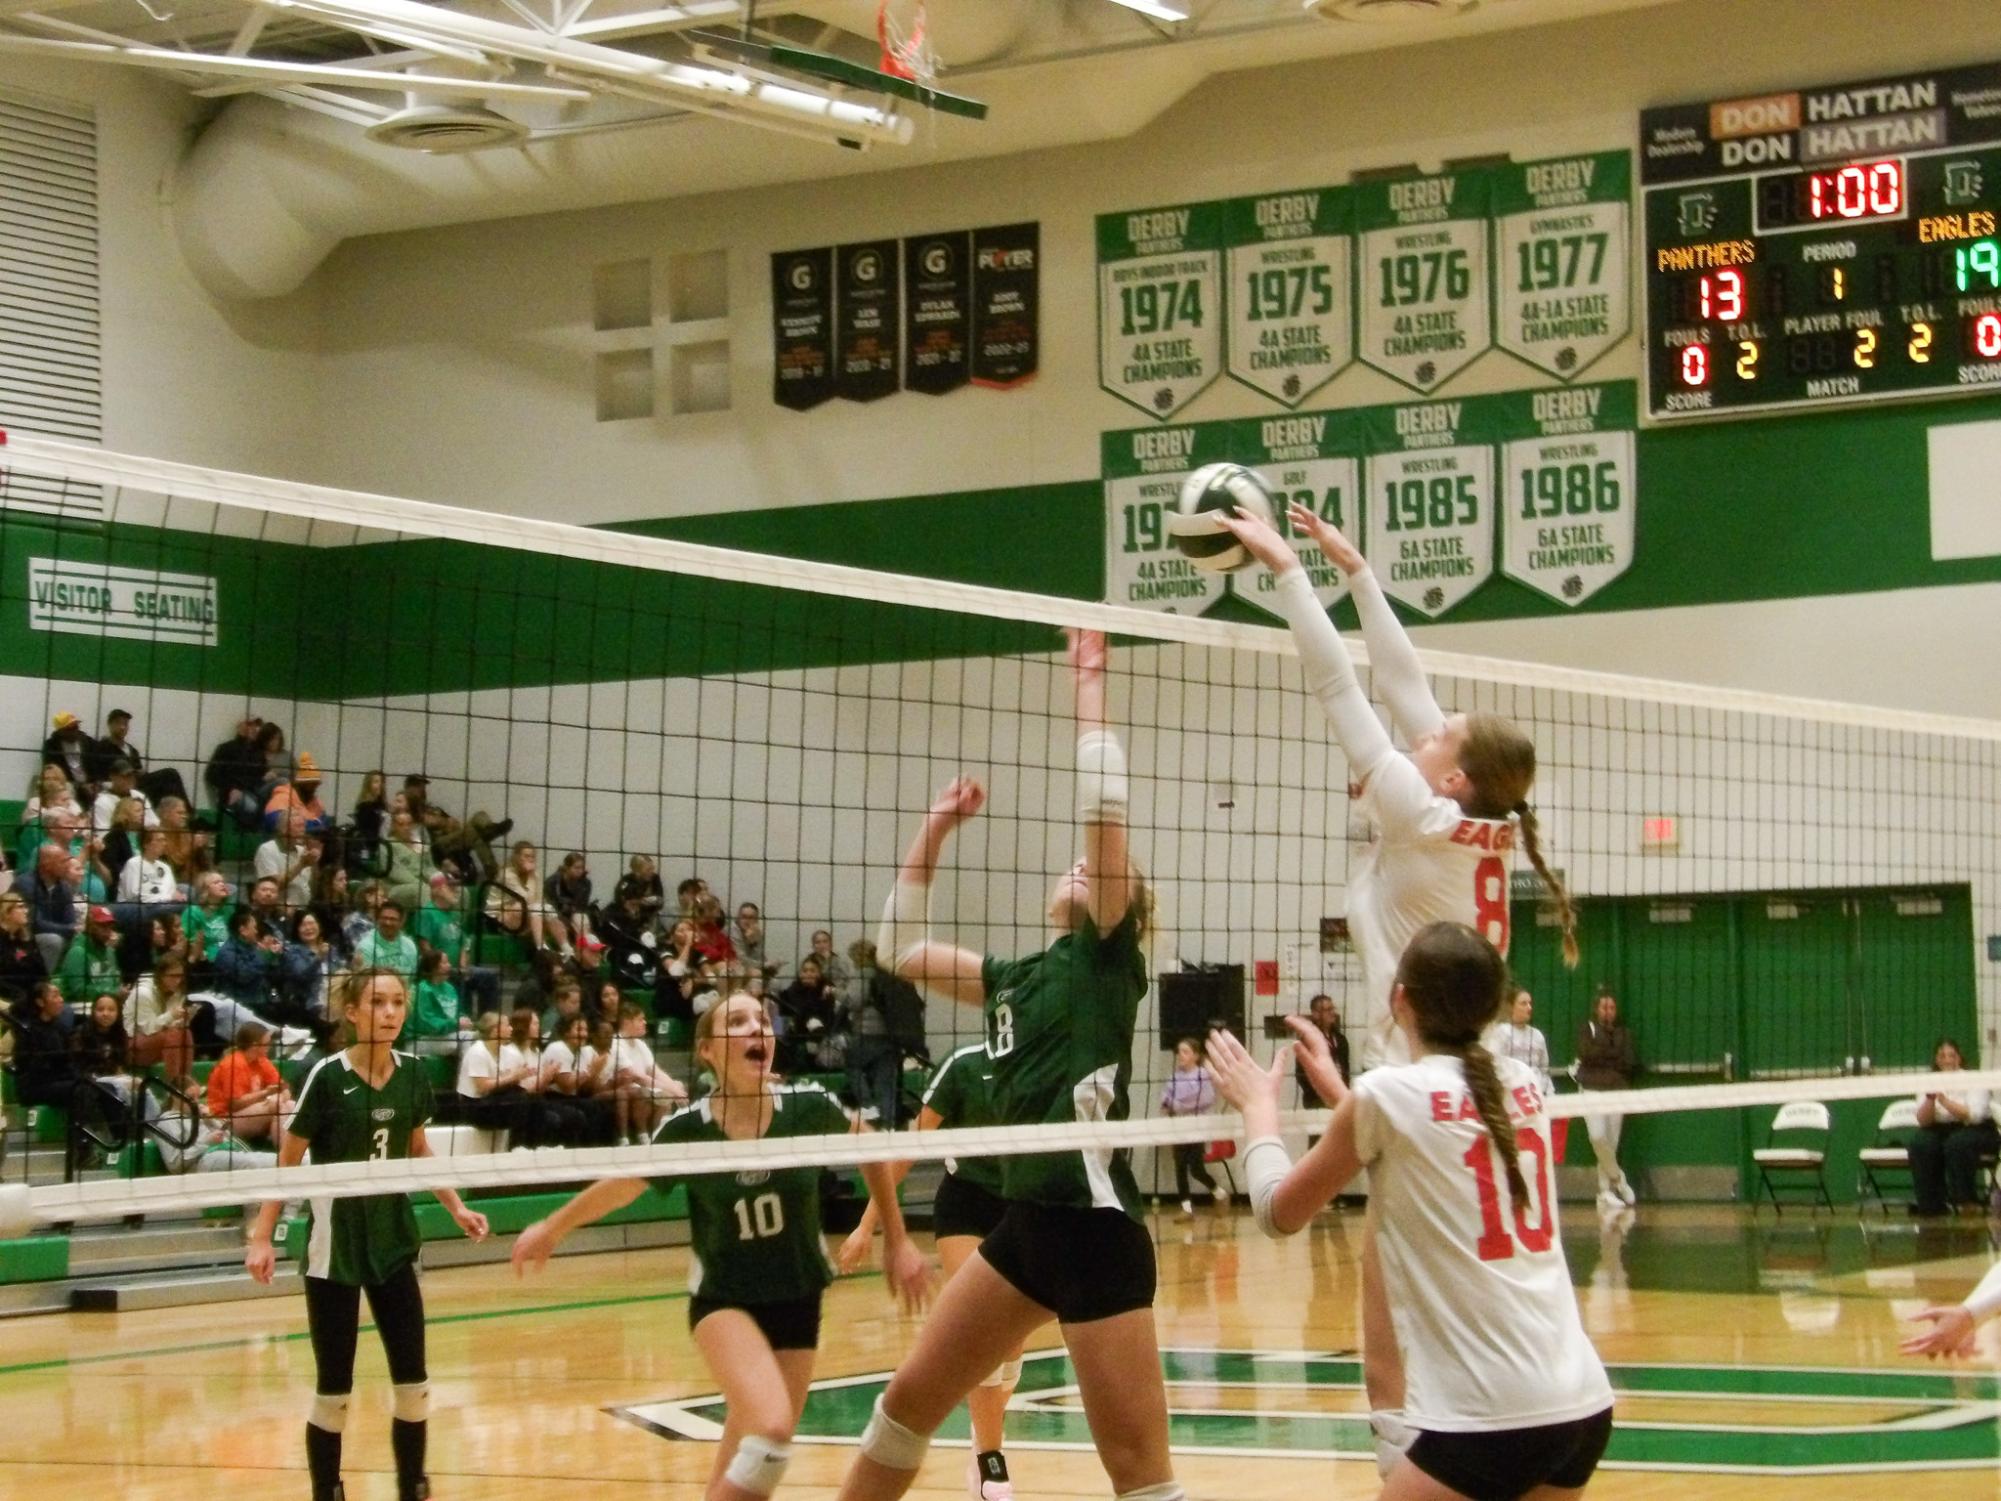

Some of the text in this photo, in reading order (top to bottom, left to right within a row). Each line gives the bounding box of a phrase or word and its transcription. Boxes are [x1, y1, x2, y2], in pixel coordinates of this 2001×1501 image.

[1808, 80, 1937, 122] HATTAN
[1721, 102, 1791, 133] DON
[1721, 135, 1791, 167] DON
[1808, 116, 1937, 156] HATTAN
[1526, 159, 1596, 194] DERBY
[1811, 163, 1898, 218] 1:00
[1256, 194, 1319, 226] DERBY
[1389, 177, 1455, 211] DERBY
[1127, 209, 1190, 242] DERBY
[1918, 211, 1996, 243] EAGLES
[925, 249, 947, 274] G
[1518, 232, 1609, 293] 1977
[1657, 239, 1756, 272] PANTHERS
[1803, 241, 1856, 263] PERIOD
[1956, 242, 2000, 291] 19
[792, 265, 811, 290] G
[856, 256, 876, 281] G
[1380, 250, 1469, 307] 1976
[1834, 267, 1843, 300] 1
[1121, 279, 1203, 335] 1974
[1247, 265, 1333, 321] 1975
[1566, 294, 1610, 316] STATE
[1701, 271, 1741, 320] 13
[1260, 325, 1321, 349] 4A STATE
[1393, 310, 1458, 335] 4A STATE
[1521, 317, 1609, 343] CHAMPIONS
[1664, 327, 1711, 347] FOULS
[1784, 309, 1884, 336] PLAYER FOUL
[1977, 316, 2001, 357] 0
[1132, 338, 1193, 362] 4A STATE
[1250, 345, 1331, 371] CHAMPIONS
[1384, 331, 1467, 357] CHAMPIONS
[1854, 329, 1876, 368] 2
[1908, 323, 1932, 363] 2
[1124, 358, 1202, 384] CHAMPIONS
[1682, 346, 1705, 386] 0
[1736, 341, 1758, 380] 2
[1958, 363, 2001, 384] SCOR
[1665, 391, 1712, 410] SCORE
[1806, 376, 1860, 397] MATCH
[1396, 403, 1462, 435] DERBY
[1533, 388, 1602, 421] DERBY
[1133, 428, 1196, 459] DERBY
[1262, 416, 1327, 447] DERBY
[1139, 482, 1182, 497] WRESTL
[1386, 475, 1478, 531] 1985
[1521, 460, 1620, 519] 1986
[1124, 502, 1179, 553] 19
[1538, 524, 1604, 548] 6A STATE
[1400, 537, 1464, 560] 6A STATE
[1529, 546, 1616, 570] CHAMPIONS
[1137, 559, 1198, 578] 4A STATE
[1391, 558, 1475, 582] CHAMPIONS
[35, 581, 214, 625] VISITOR SEATING
[1129, 579, 1207, 601] CHAMPIONS
[1474, 856, 1509, 955] 8
[1430, 1083, 1543, 1122] EAES
[369, 1128, 390, 1162] 3
[1463, 1127, 1554, 1261] 10
[734, 1193, 784, 1241] 10
